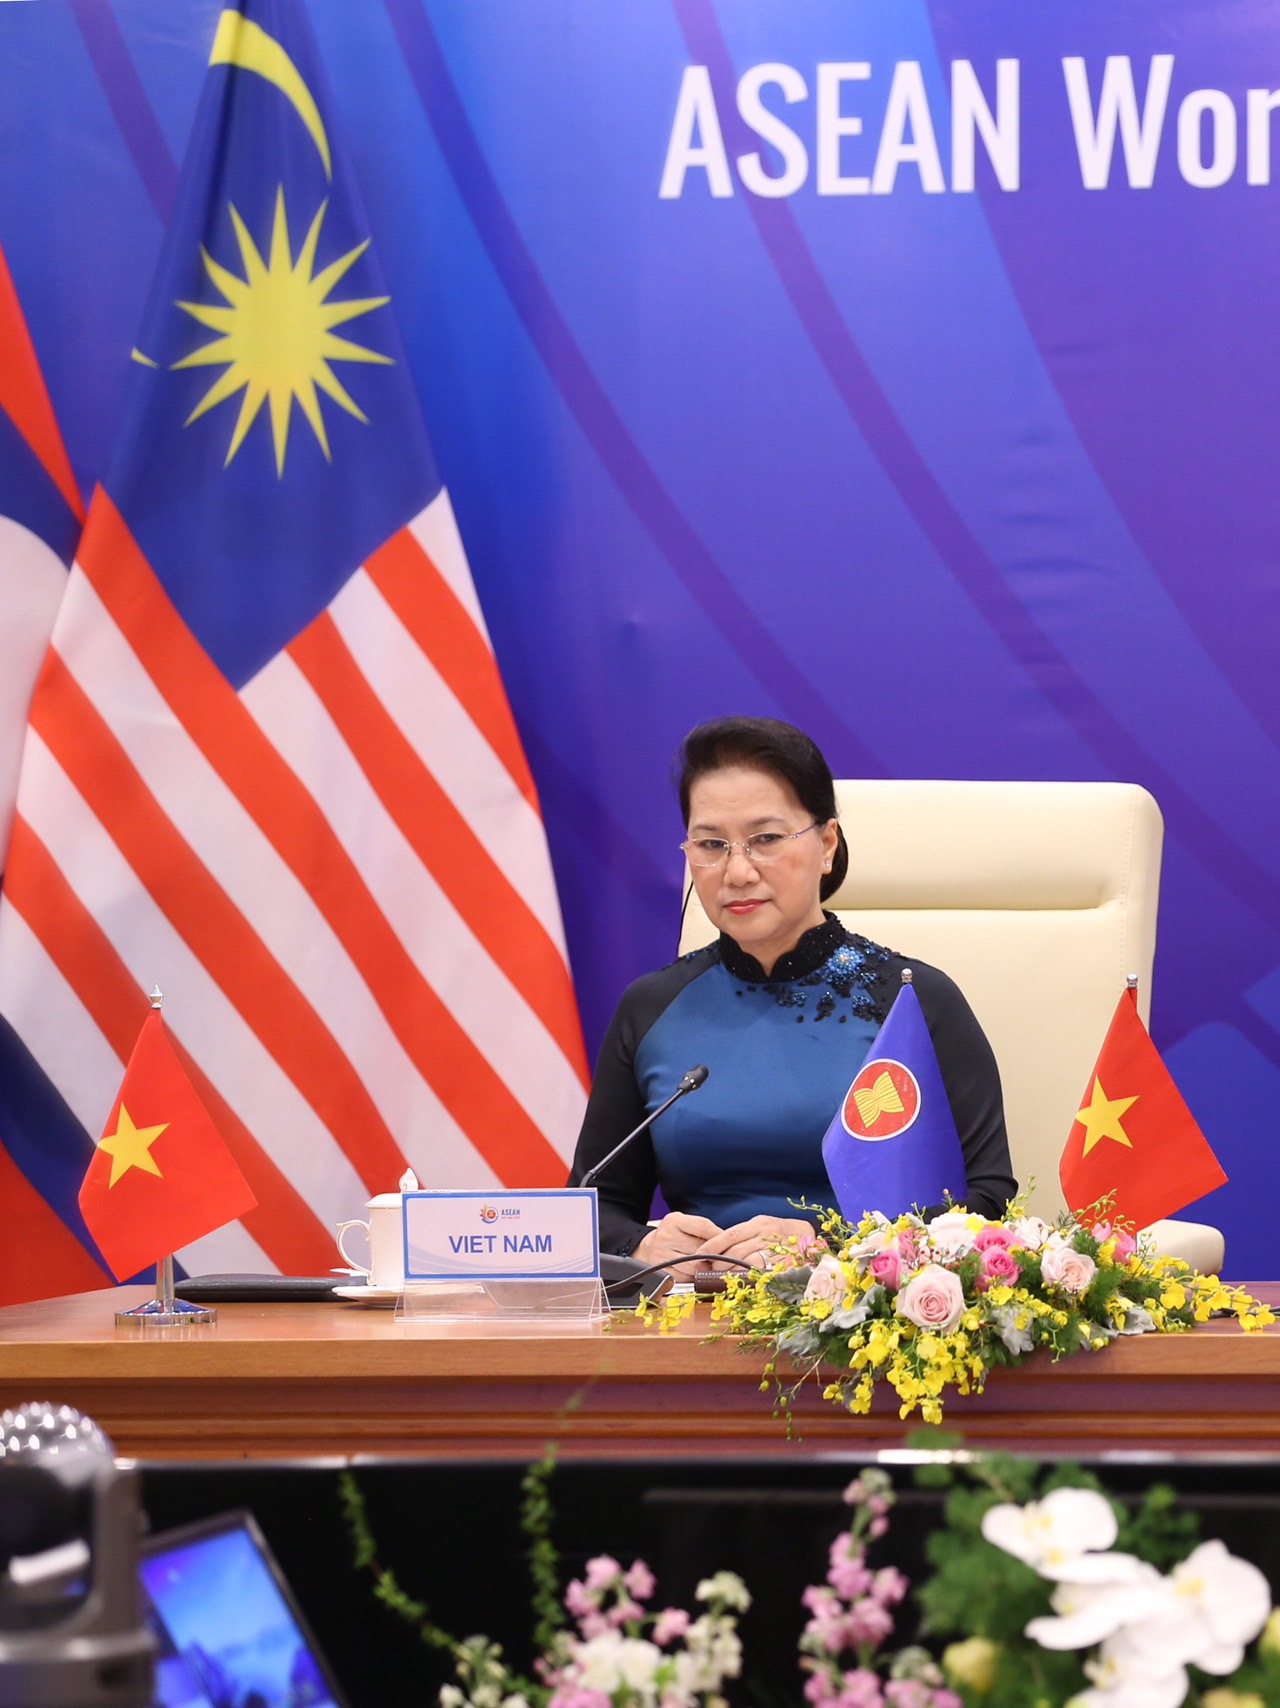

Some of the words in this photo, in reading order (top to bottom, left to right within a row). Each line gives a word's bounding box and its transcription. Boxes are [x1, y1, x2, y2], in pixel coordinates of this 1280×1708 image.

[658, 58, 1020, 199] ASEAN
[501, 1208, 521, 1216] ASEAN
[448, 1235, 498, 1253] VIET
[504, 1234, 552, 1253] NAM
